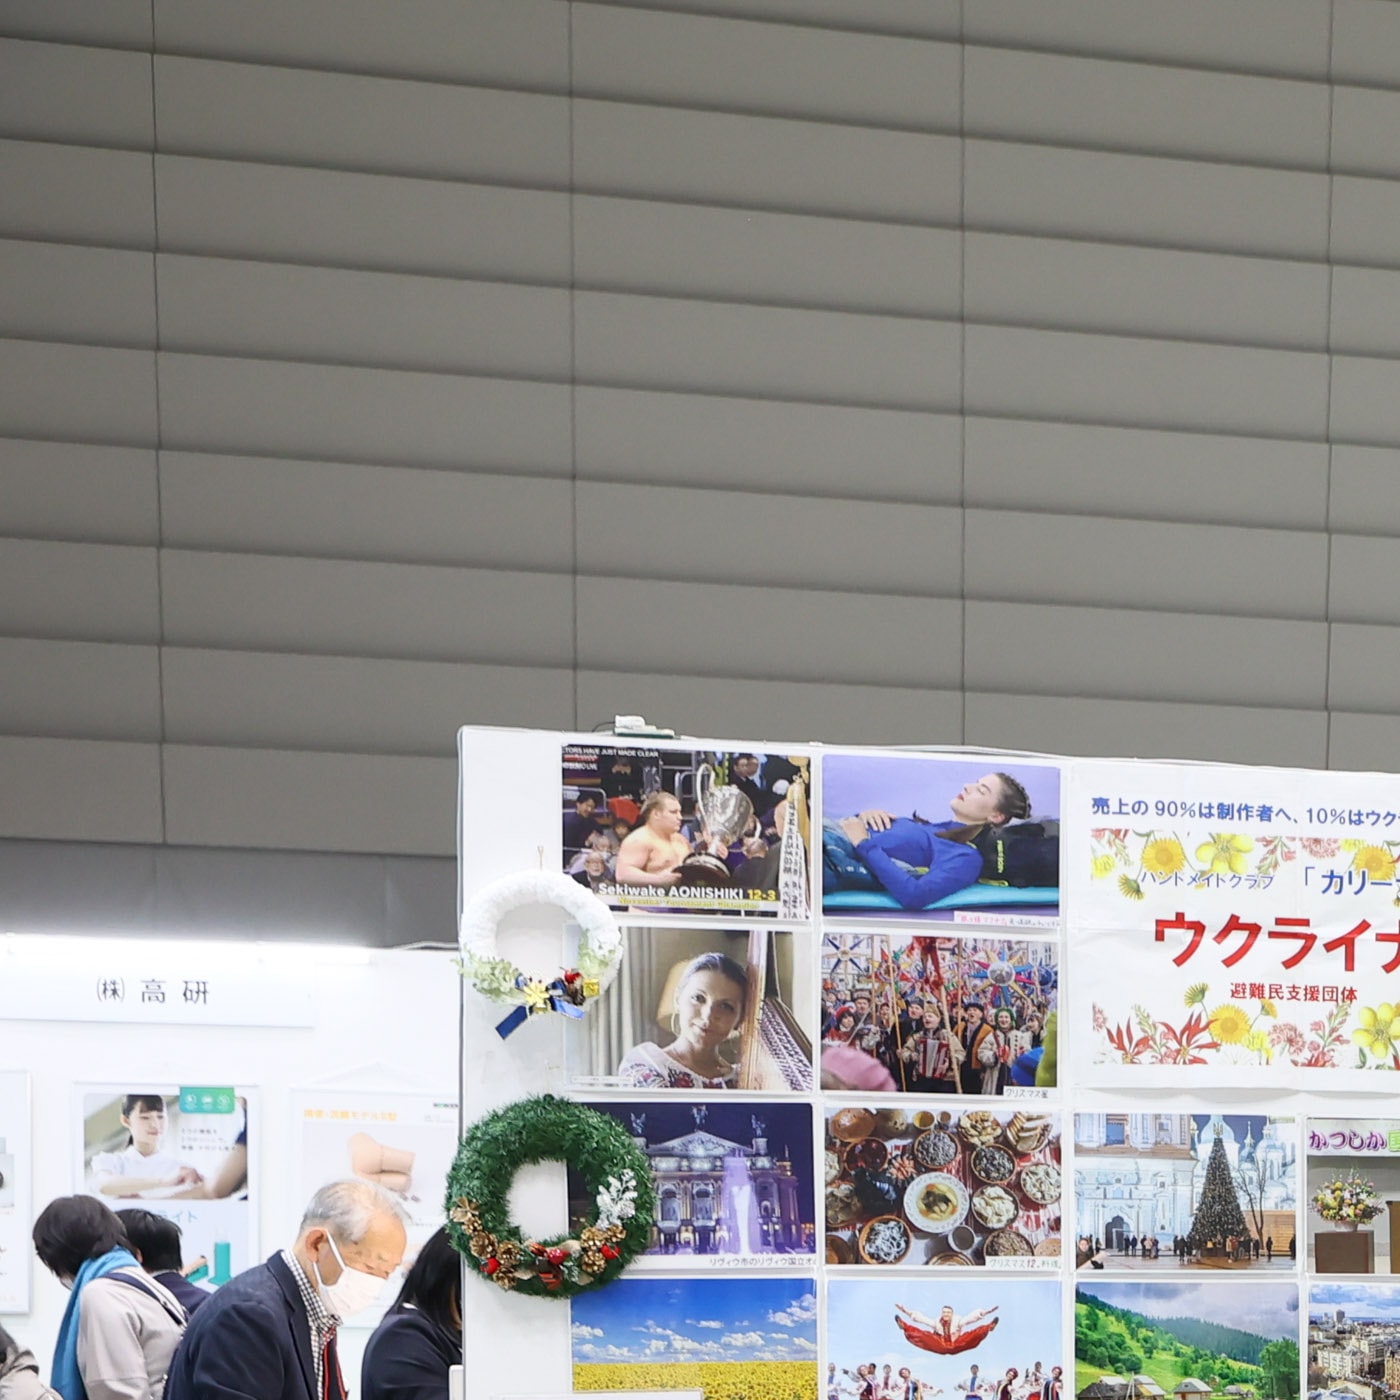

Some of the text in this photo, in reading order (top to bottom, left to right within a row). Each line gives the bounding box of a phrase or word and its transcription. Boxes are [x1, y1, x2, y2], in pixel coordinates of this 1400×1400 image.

[598, 882, 777, 901] Sekiwake AONISHIKI 12-3
[1229, 981, 1358, 1003] 避難民支援団体
